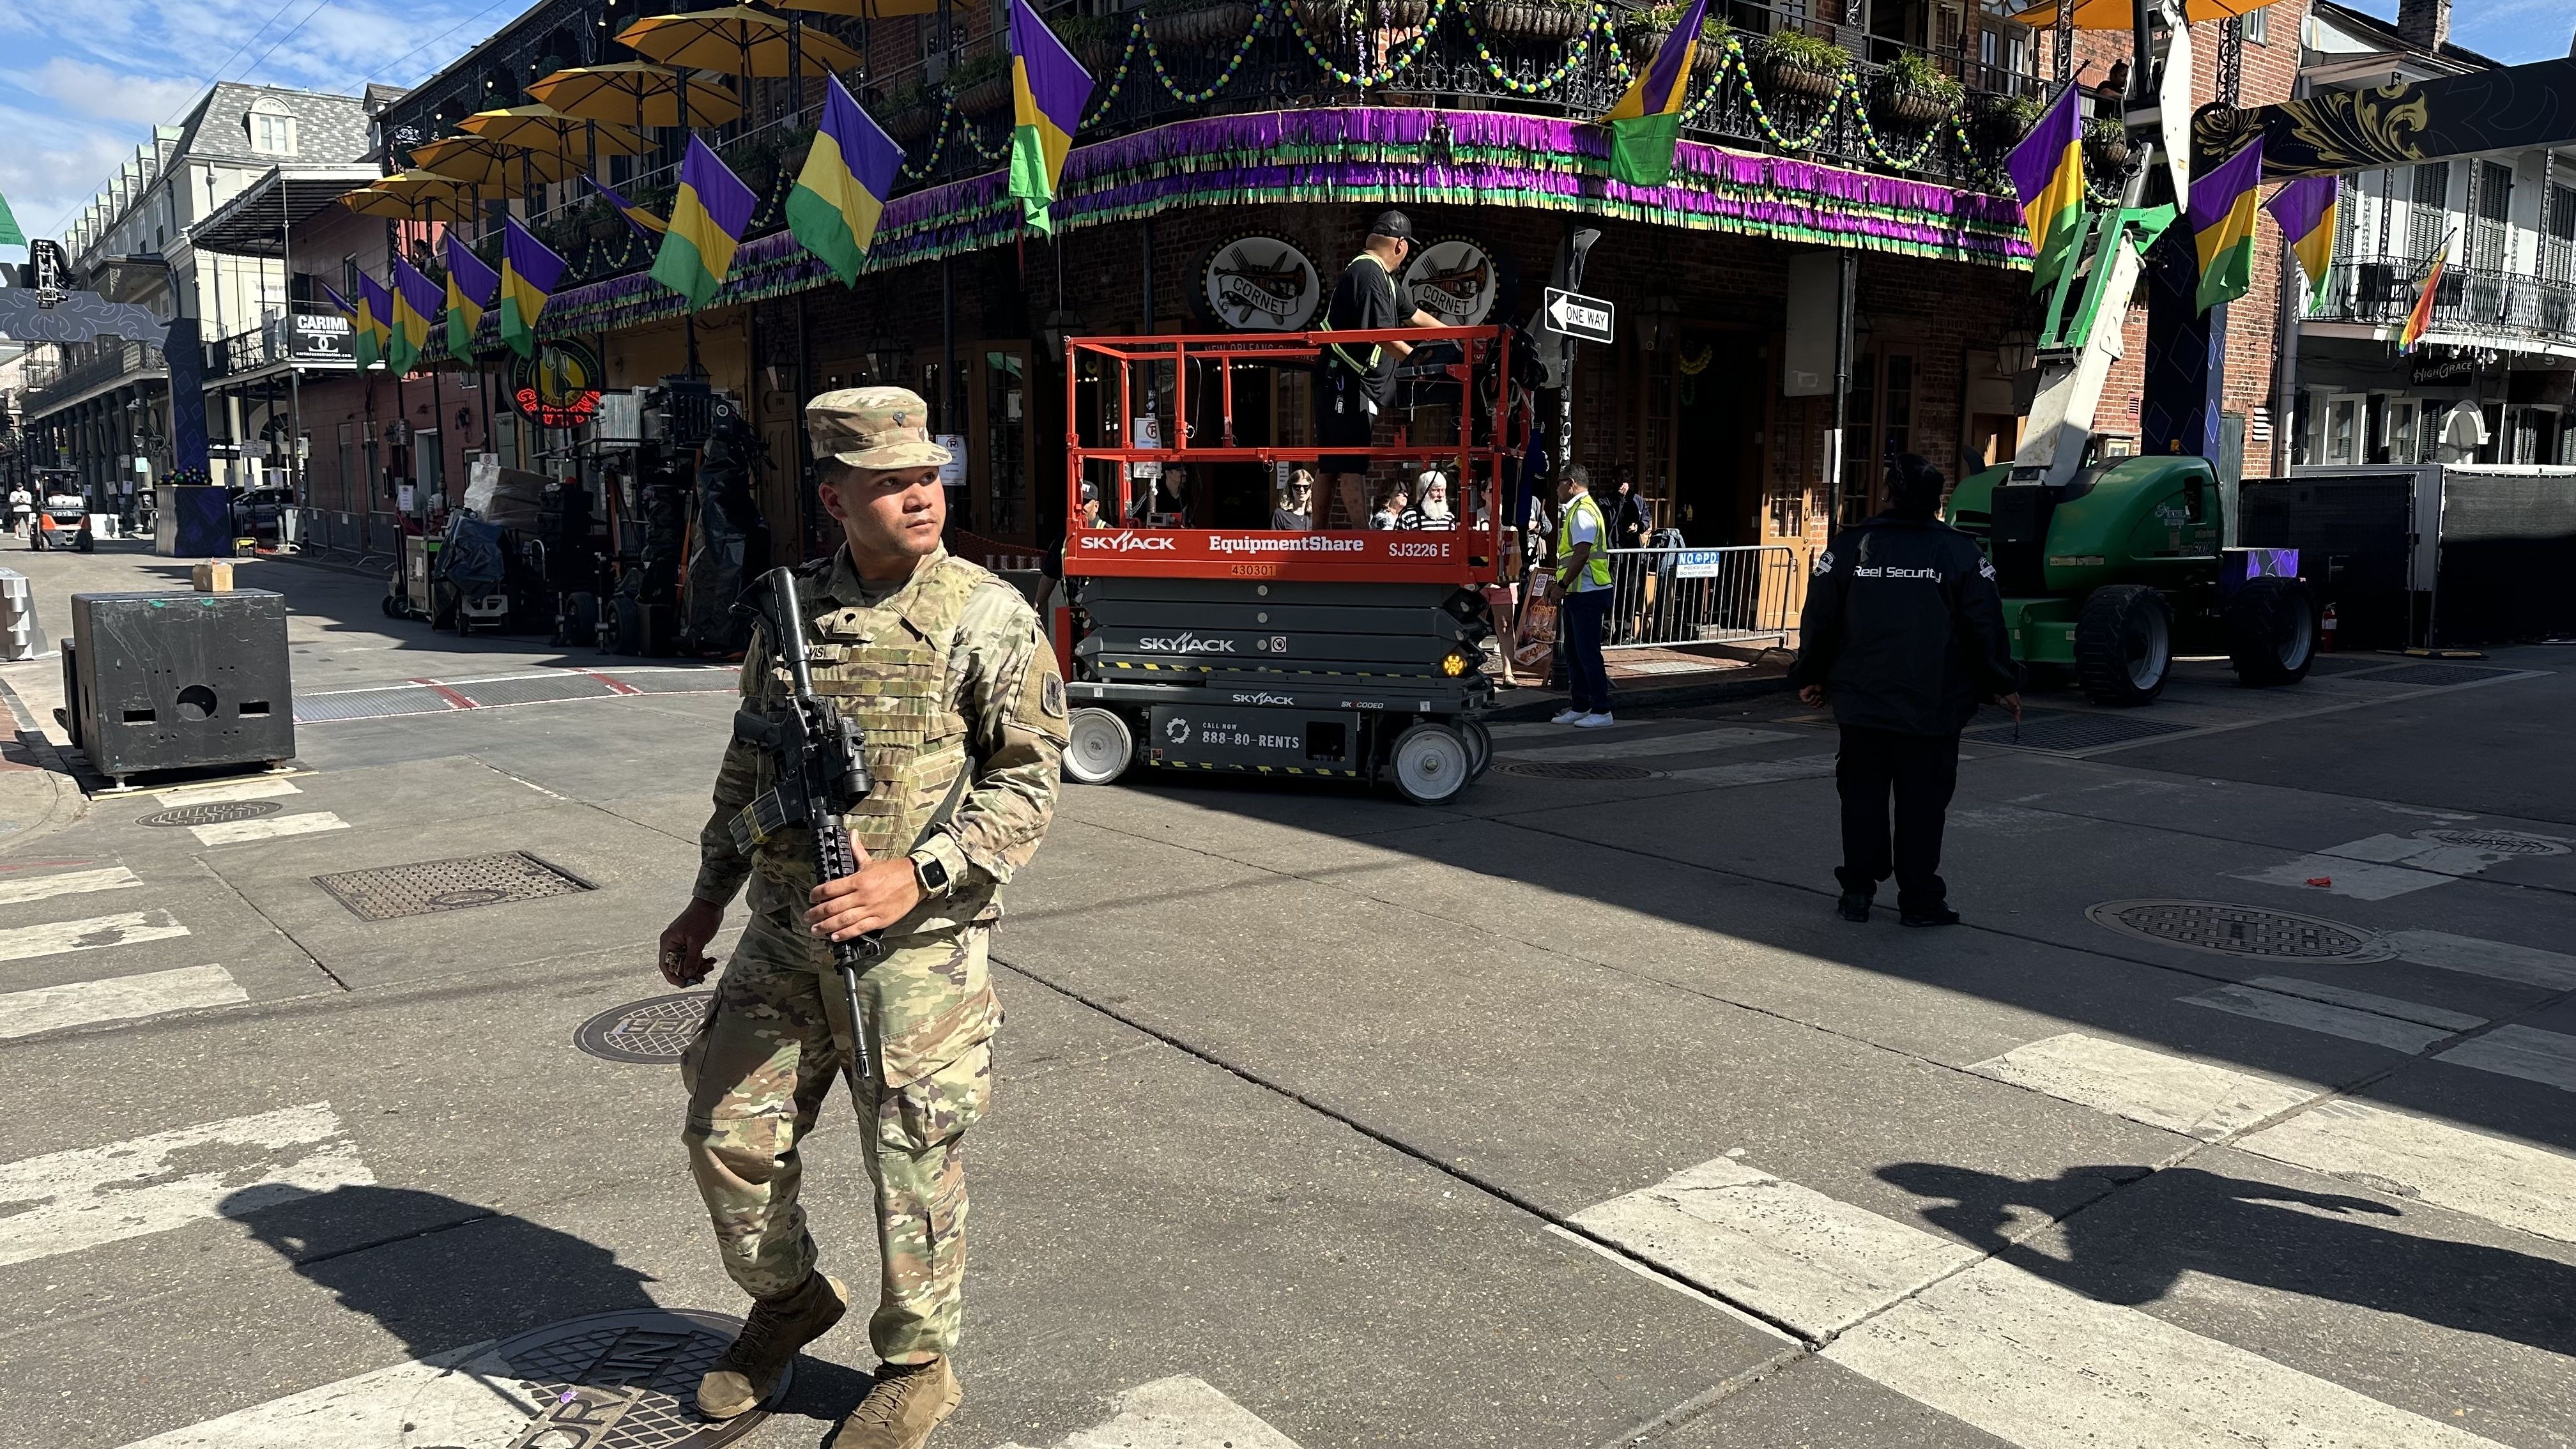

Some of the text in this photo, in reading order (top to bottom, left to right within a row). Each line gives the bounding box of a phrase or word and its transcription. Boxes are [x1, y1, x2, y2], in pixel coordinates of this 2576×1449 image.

[1233, 277, 1288, 314] CORNET
[1423, 285, 1469, 314] CORNET
[297, 315, 348, 330] CARIMI
[1567, 305, 1606, 328] ONE WAY
[572, 347, 598, 378] GRANDE
[1080, 530, 1176, 552] SKYJACK
[1209, 535, 1364, 554] EquipmentShare
[1388, 543, 1450, 557] SJ3226 E
[1232, 565, 1273, 575] 430301
[1853, 565, 1942, 583] Reel Security
[1533, 604, 1556, 616] CORNET
[1139, 631, 1236, 654] SKYJACK
[1232, 691, 1294, 705] SKYJACK
[1202, 732, 1300, 749] 888-80-RENTS
